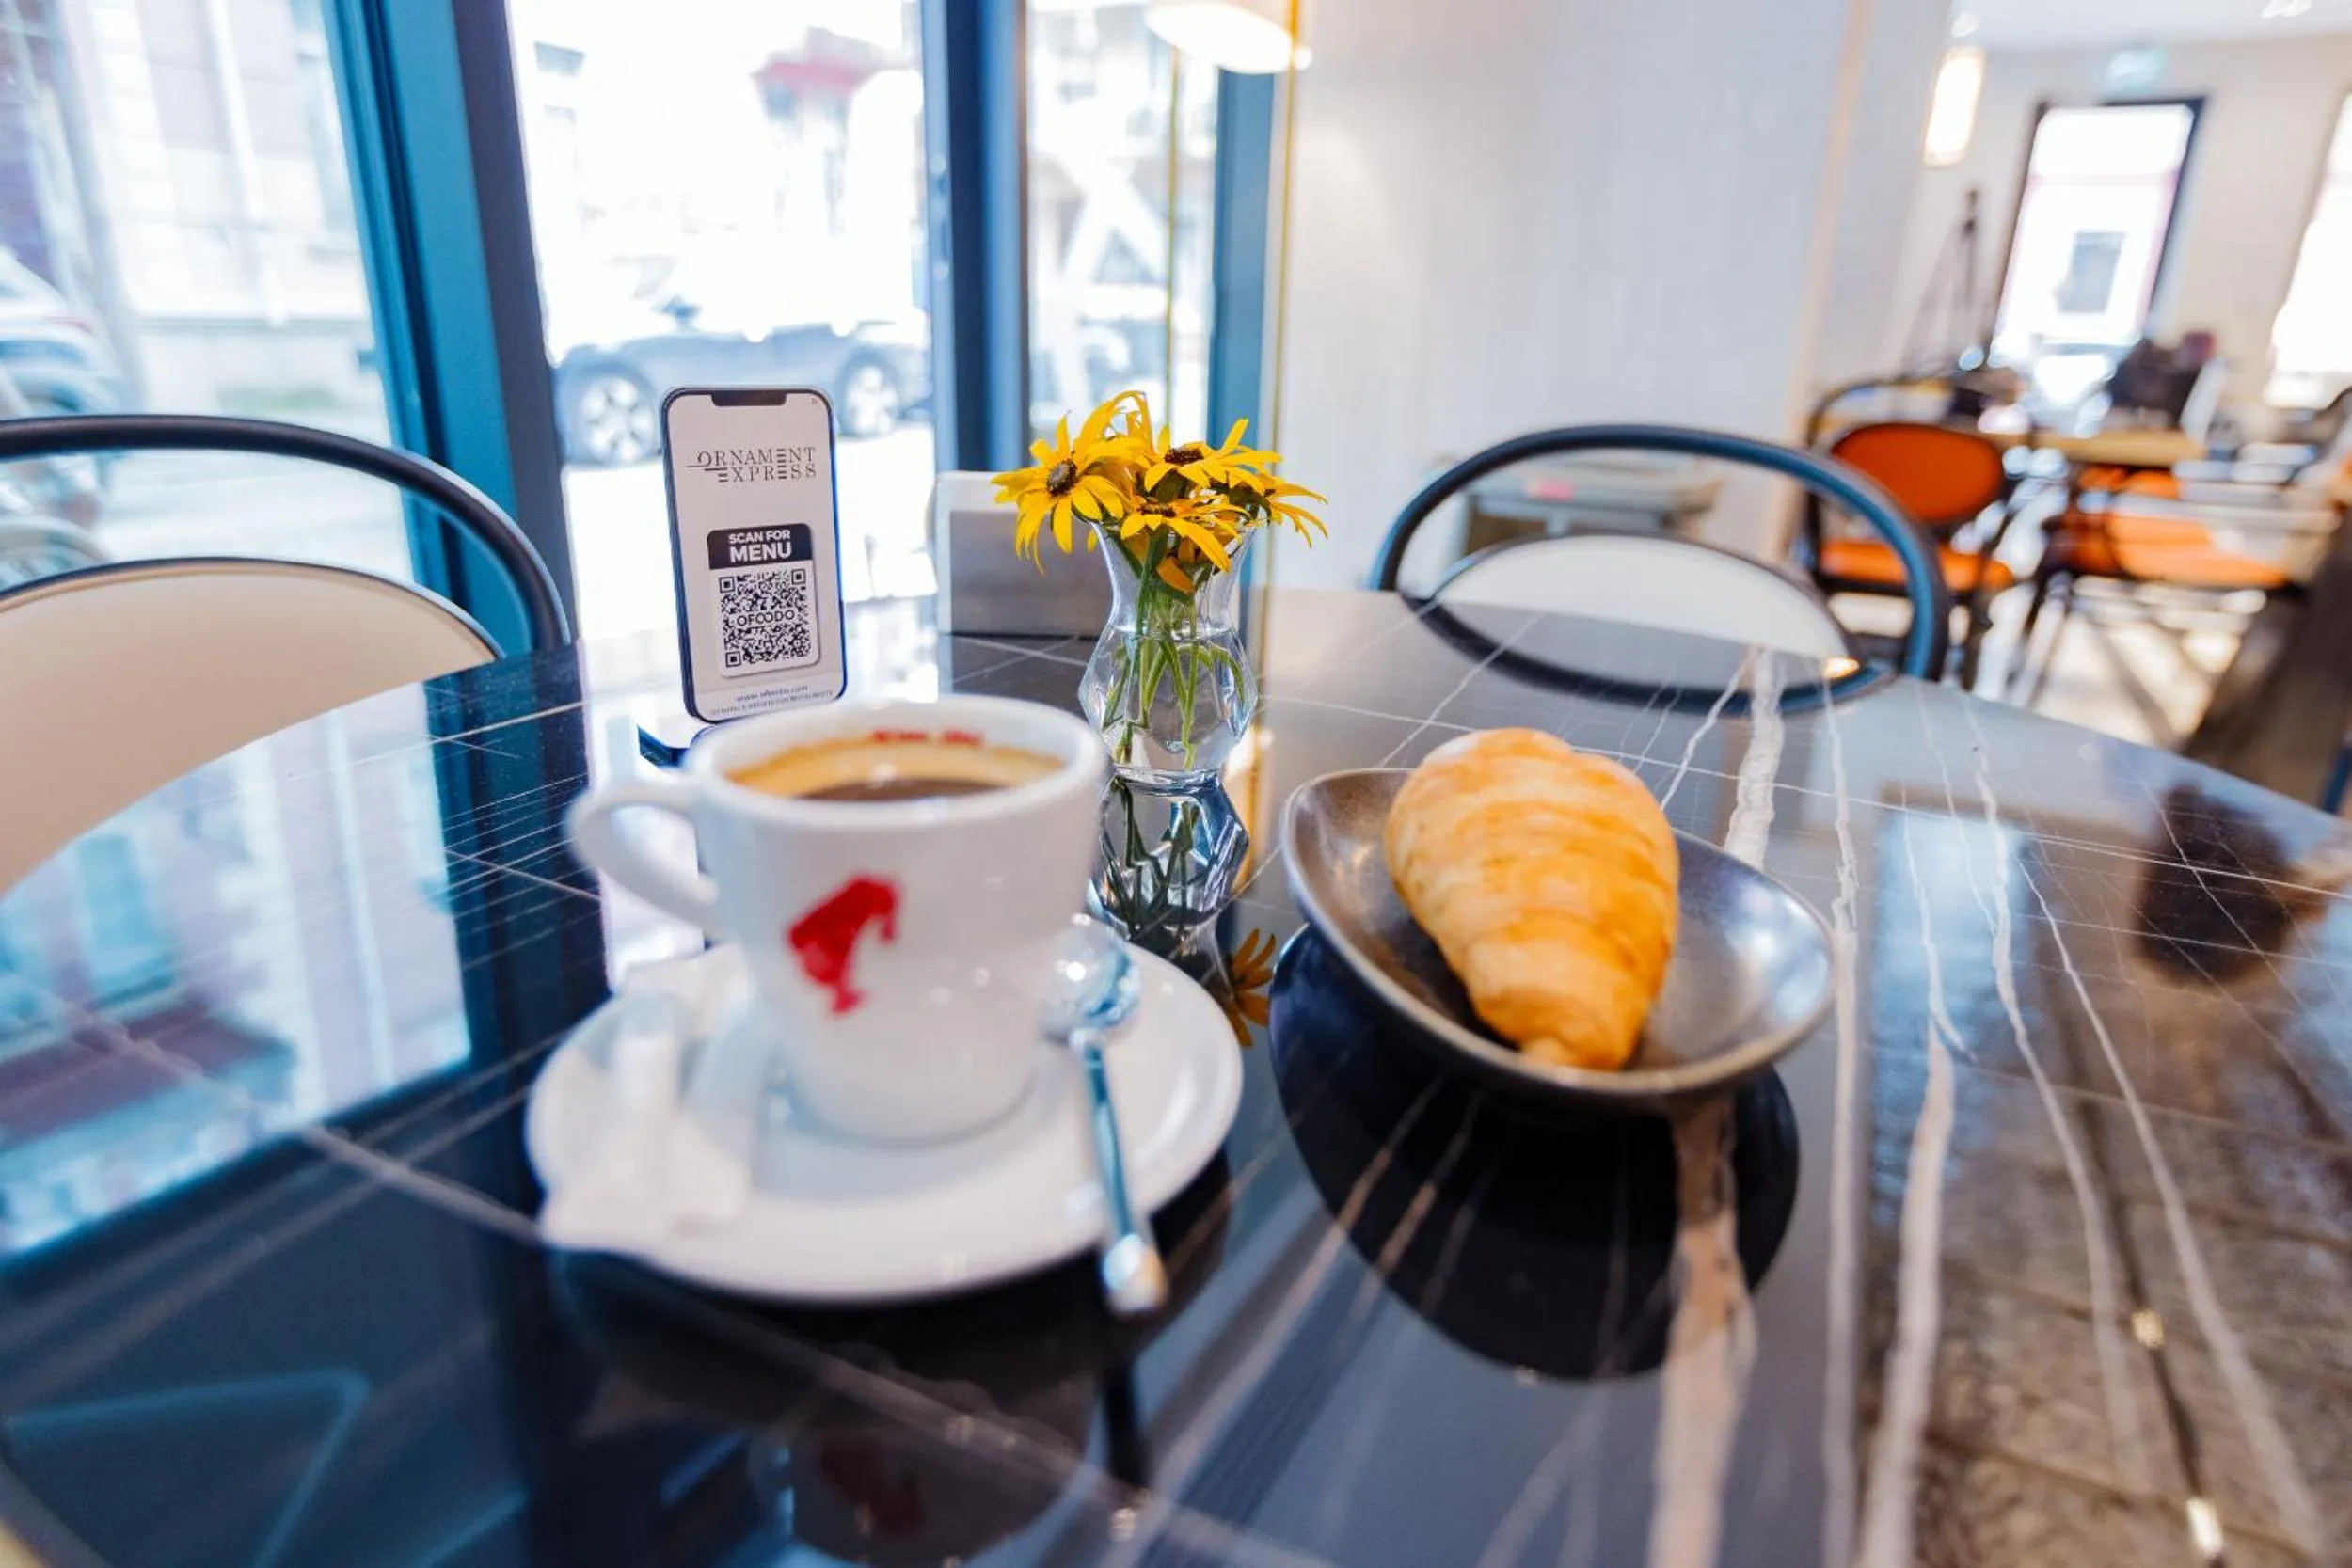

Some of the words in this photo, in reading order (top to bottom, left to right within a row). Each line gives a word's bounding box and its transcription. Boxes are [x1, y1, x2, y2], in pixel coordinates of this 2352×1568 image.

[686, 447, 817, 468] ORNAMENT
[704, 464, 817, 483] EXPRESS
[728, 531, 764, 545] SCAN
[766, 530, 791, 541] FOR
[729, 542, 792, 563] MENU
[737, 610, 795, 626] OFOODO
